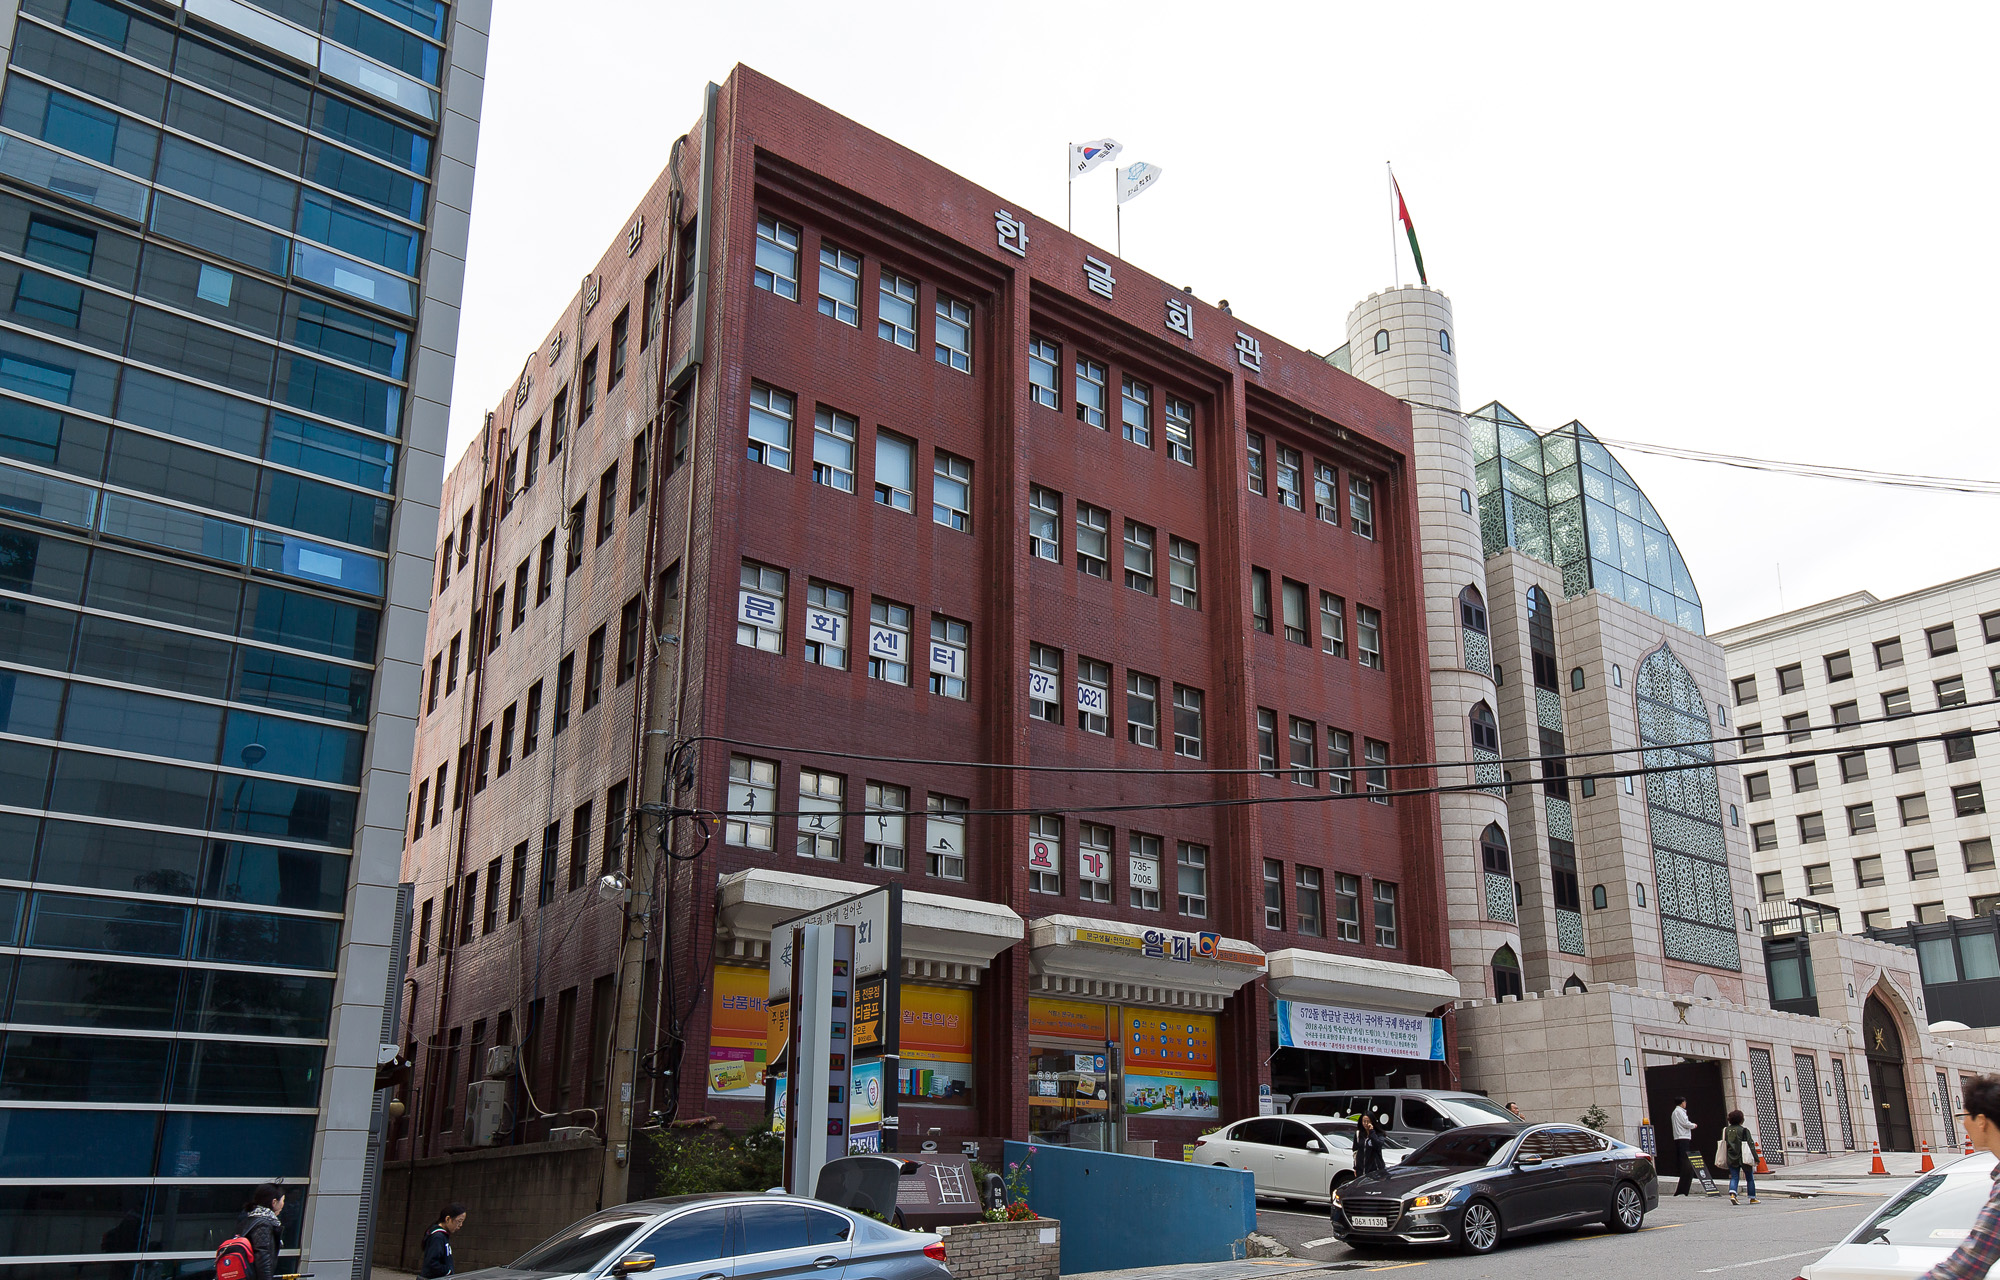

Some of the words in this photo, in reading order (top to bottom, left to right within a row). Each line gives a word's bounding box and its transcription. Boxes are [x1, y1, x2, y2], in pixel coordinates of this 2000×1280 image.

[744, 595, 957, 674] 문화센터
[1078, 684, 1104, 710] 0621
[1031, 842, 1104, 878] 요가
[1132, 859, 1153, 871] 735-
[1132, 873, 1153, 886] 7005
[843, 900, 864, 920] 걸어온
[1143, 930, 1193, 963] 알파
[862, 985, 880, 1001] 전문점
[1300, 1007, 1319, 1021] 572돌
[1320, 1009, 1342, 1024] 한글날
[1385, 1016, 1398, 1029] 국제
[1398, 1018, 1423, 1032] 학술대회
[1318, 1024, 1332, 1033] 주시경
[1368, 1218, 1384, 1227] 1130
